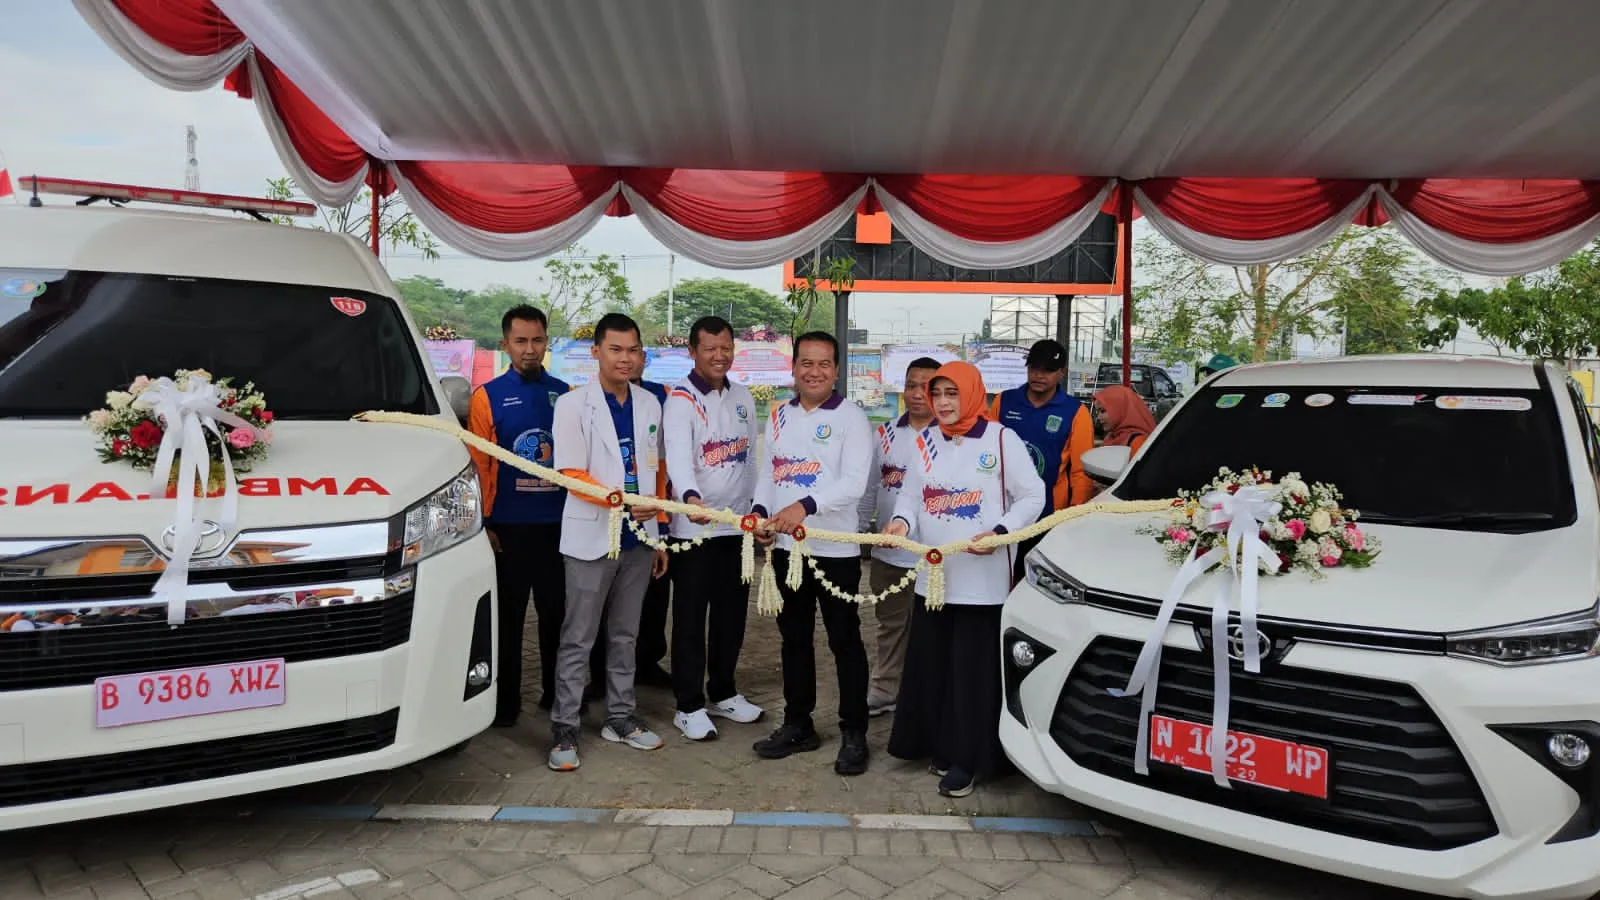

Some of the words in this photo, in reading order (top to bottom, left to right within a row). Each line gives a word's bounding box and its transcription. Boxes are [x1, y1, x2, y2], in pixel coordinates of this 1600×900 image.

[101, 682, 119, 710] B
[138, 671, 211, 704] 9386
[229, 663, 280, 694] XWZ
[1157, 719, 1173, 748] N
[1285, 746, 1322, 779] WP
